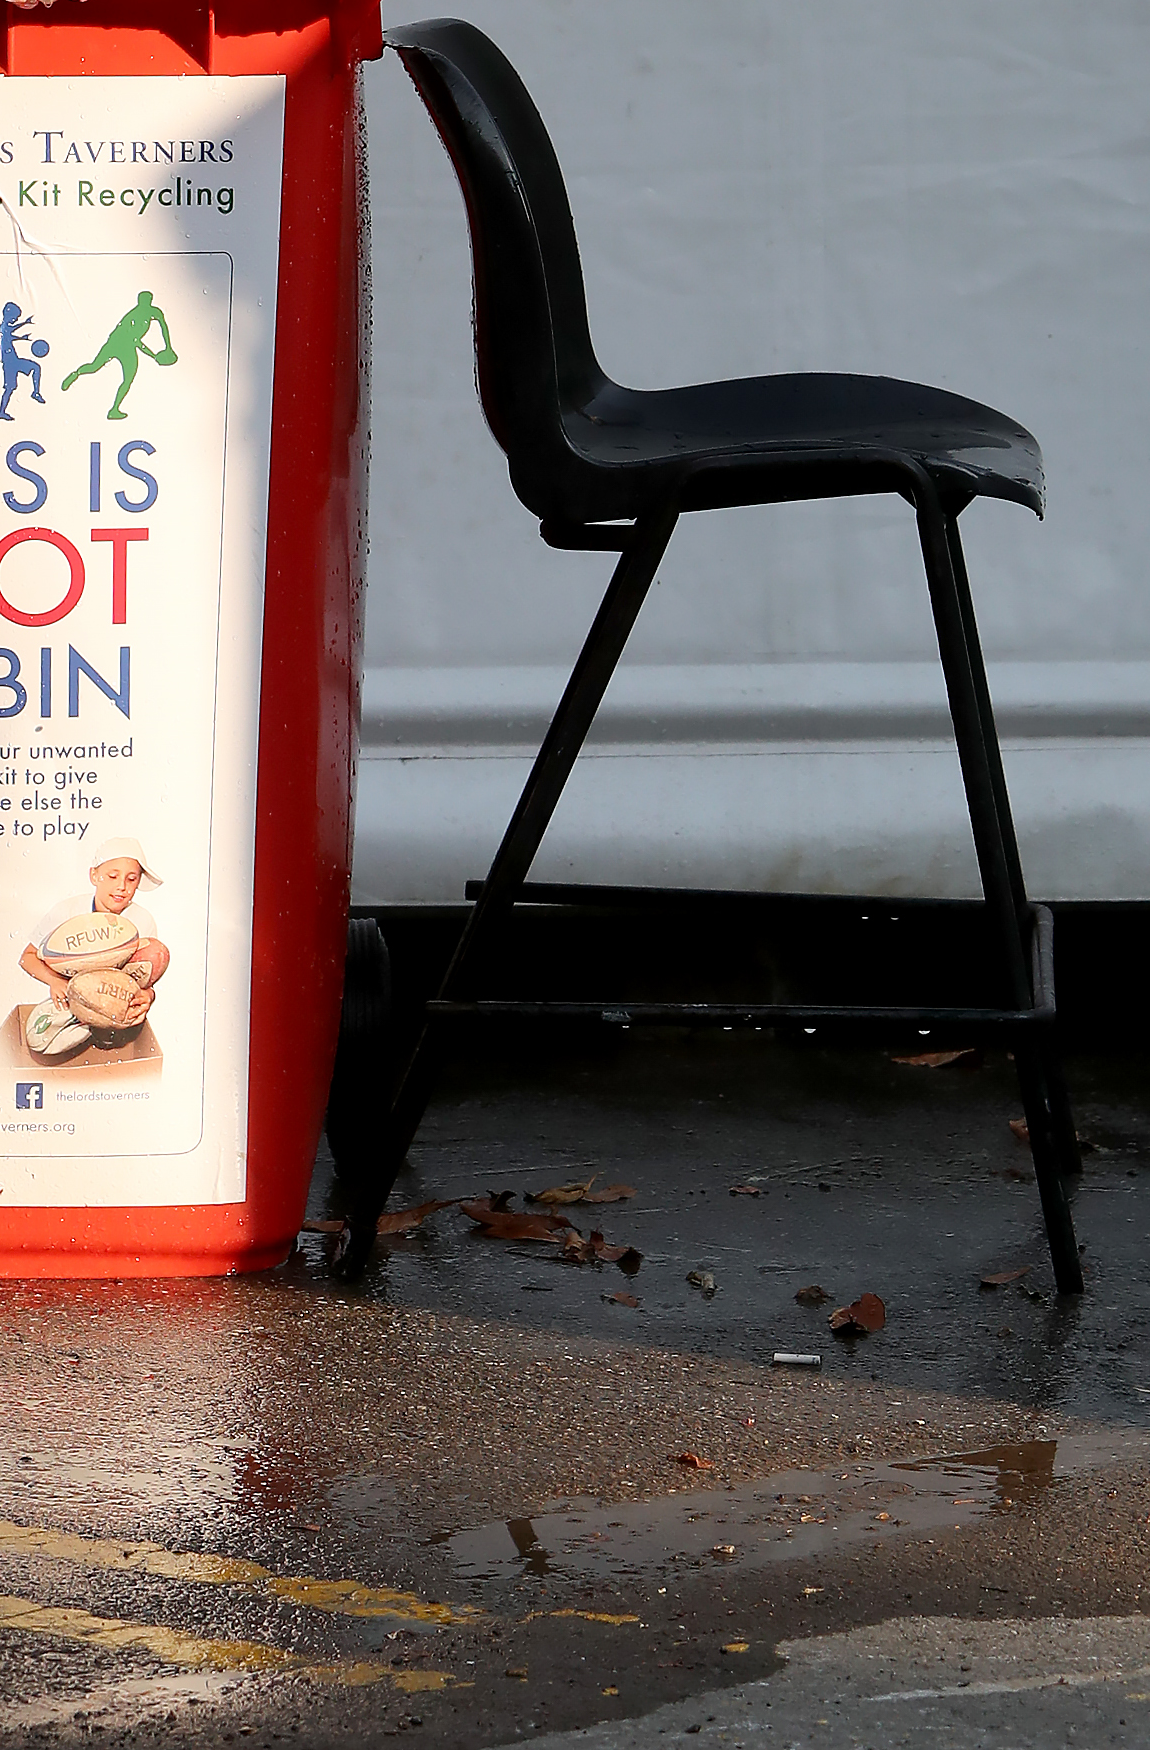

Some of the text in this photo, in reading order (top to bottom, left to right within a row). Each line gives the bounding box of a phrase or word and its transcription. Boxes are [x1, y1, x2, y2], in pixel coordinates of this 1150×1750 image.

[33, 131, 234, 164] TAVERNERS
[18, 180, 61, 207] Kit
[78, 178, 235, 214] Recycling
[89, 440, 159, 514] IS
[29, 737, 133, 759] unwanted
[24, 767, 45, 785] to
[54, 766, 98, 791] give
[20, 790, 61, 810] else
[70, 790, 103, 810] the
[13, 819, 34, 837] to
[42, 815, 89, 841] play
[66, 927, 110, 950] RFUW
[55, 1088, 150, 1102] thelordstaverners
